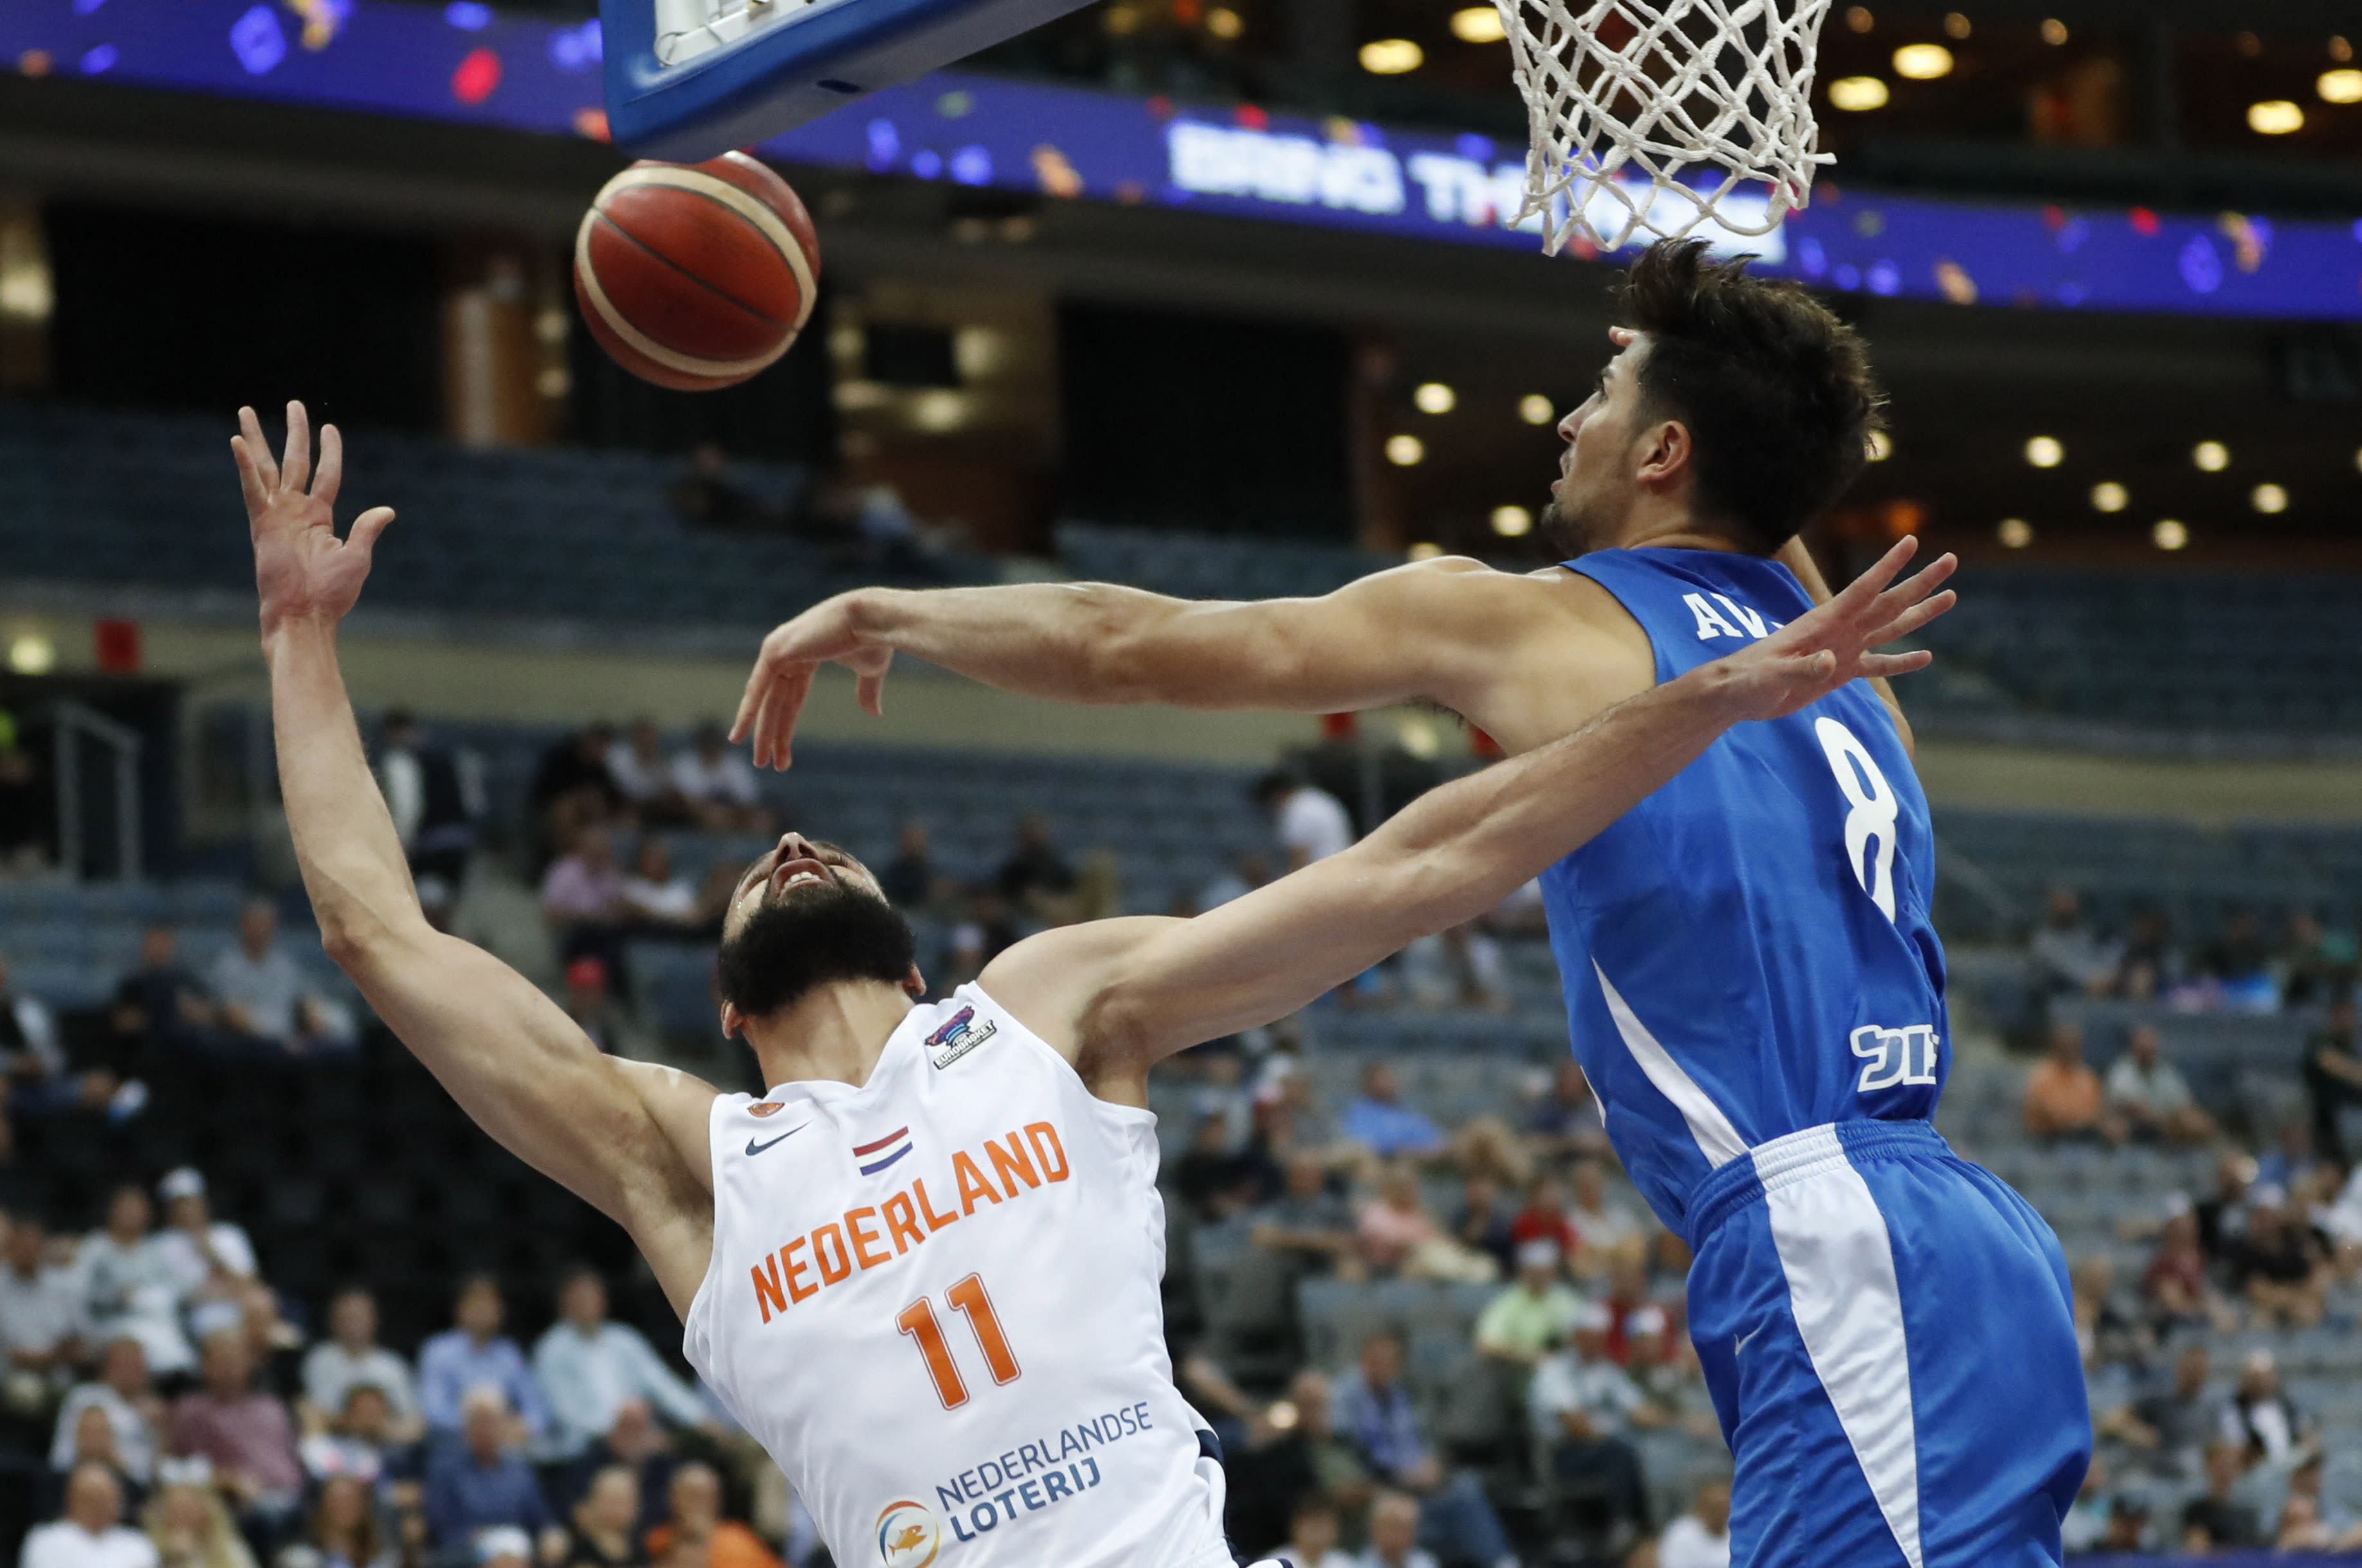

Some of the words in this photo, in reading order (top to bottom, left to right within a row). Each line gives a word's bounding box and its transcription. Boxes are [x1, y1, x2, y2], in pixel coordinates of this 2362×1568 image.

[1682, 592, 1784, 641] AV
[1815, 716, 1898, 925] 8
[751, 1122, 1069, 1324] NEDERLAND
[895, 1272, 1021, 1410] 11
[936, 1401, 1153, 1511] NEDERLANDSE
[950, 1456, 1101, 1542] LOTERIJ
